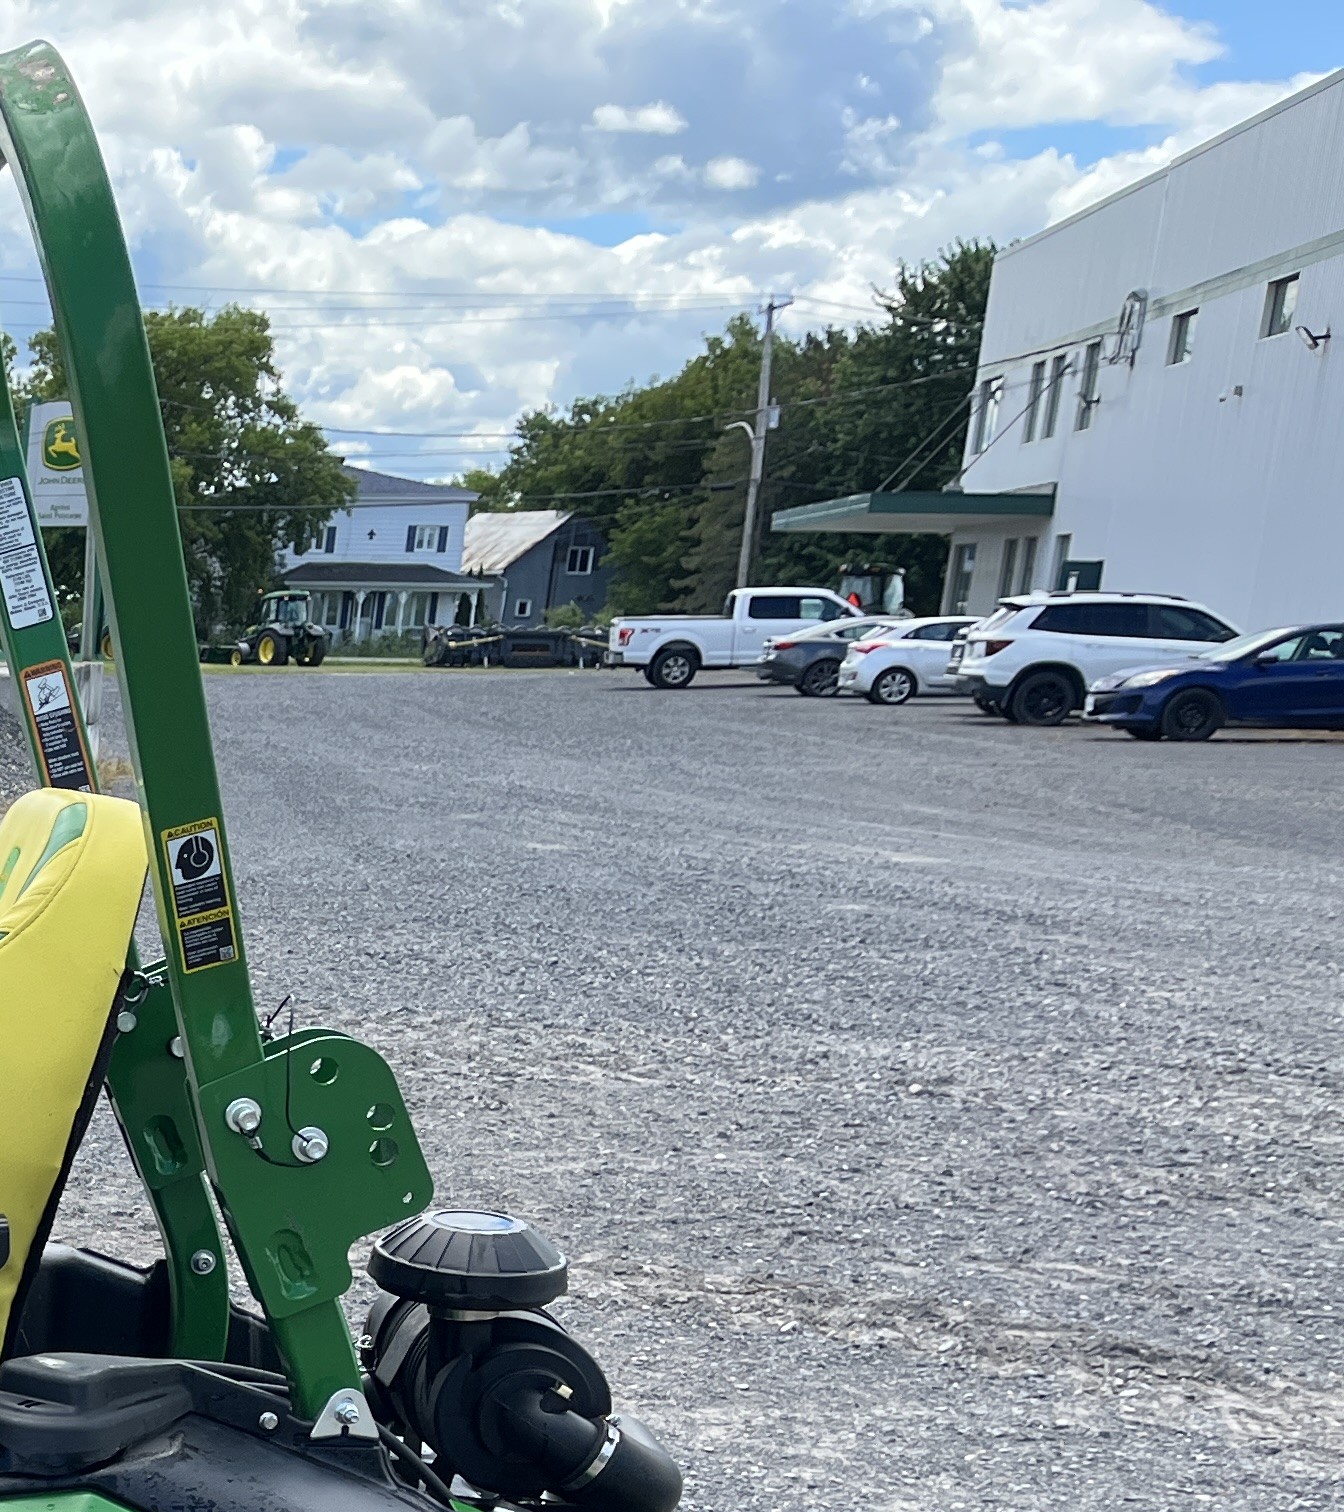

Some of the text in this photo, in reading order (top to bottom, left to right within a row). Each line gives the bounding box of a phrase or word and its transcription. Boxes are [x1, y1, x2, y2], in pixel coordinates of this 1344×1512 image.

[38, 476, 84, 485] JOHN DEER
[173, 820, 214, 837] CAUTION
[186, 908, 230, 926] ATENCIÓN
